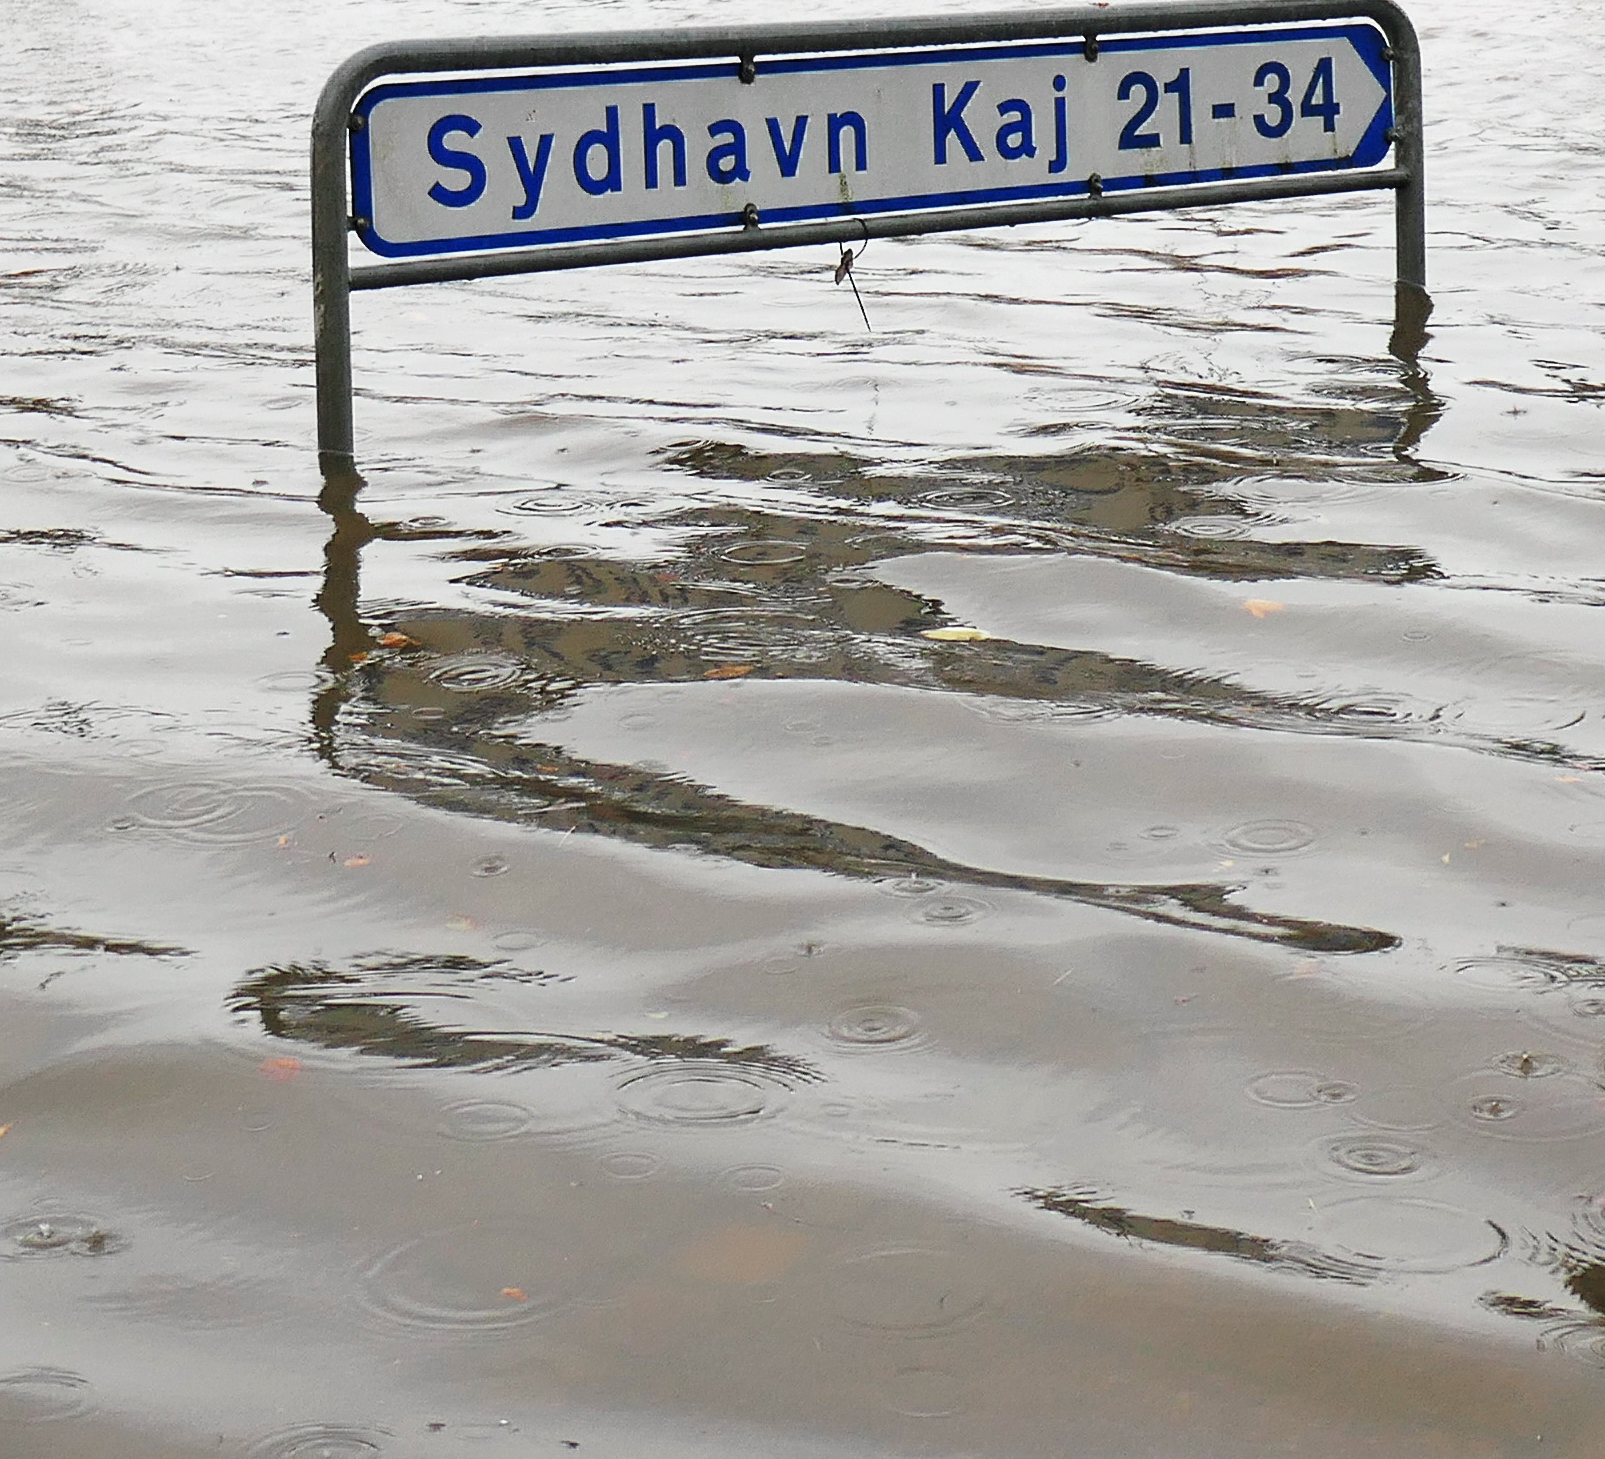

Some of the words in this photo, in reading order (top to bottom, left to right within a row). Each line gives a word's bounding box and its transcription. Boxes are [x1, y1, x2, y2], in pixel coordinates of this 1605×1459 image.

[427, 102, 868, 221] Sydhavn
[932, 74, 1068, 175] Kaj
[1117, 57, 1341, 151] 21-34
